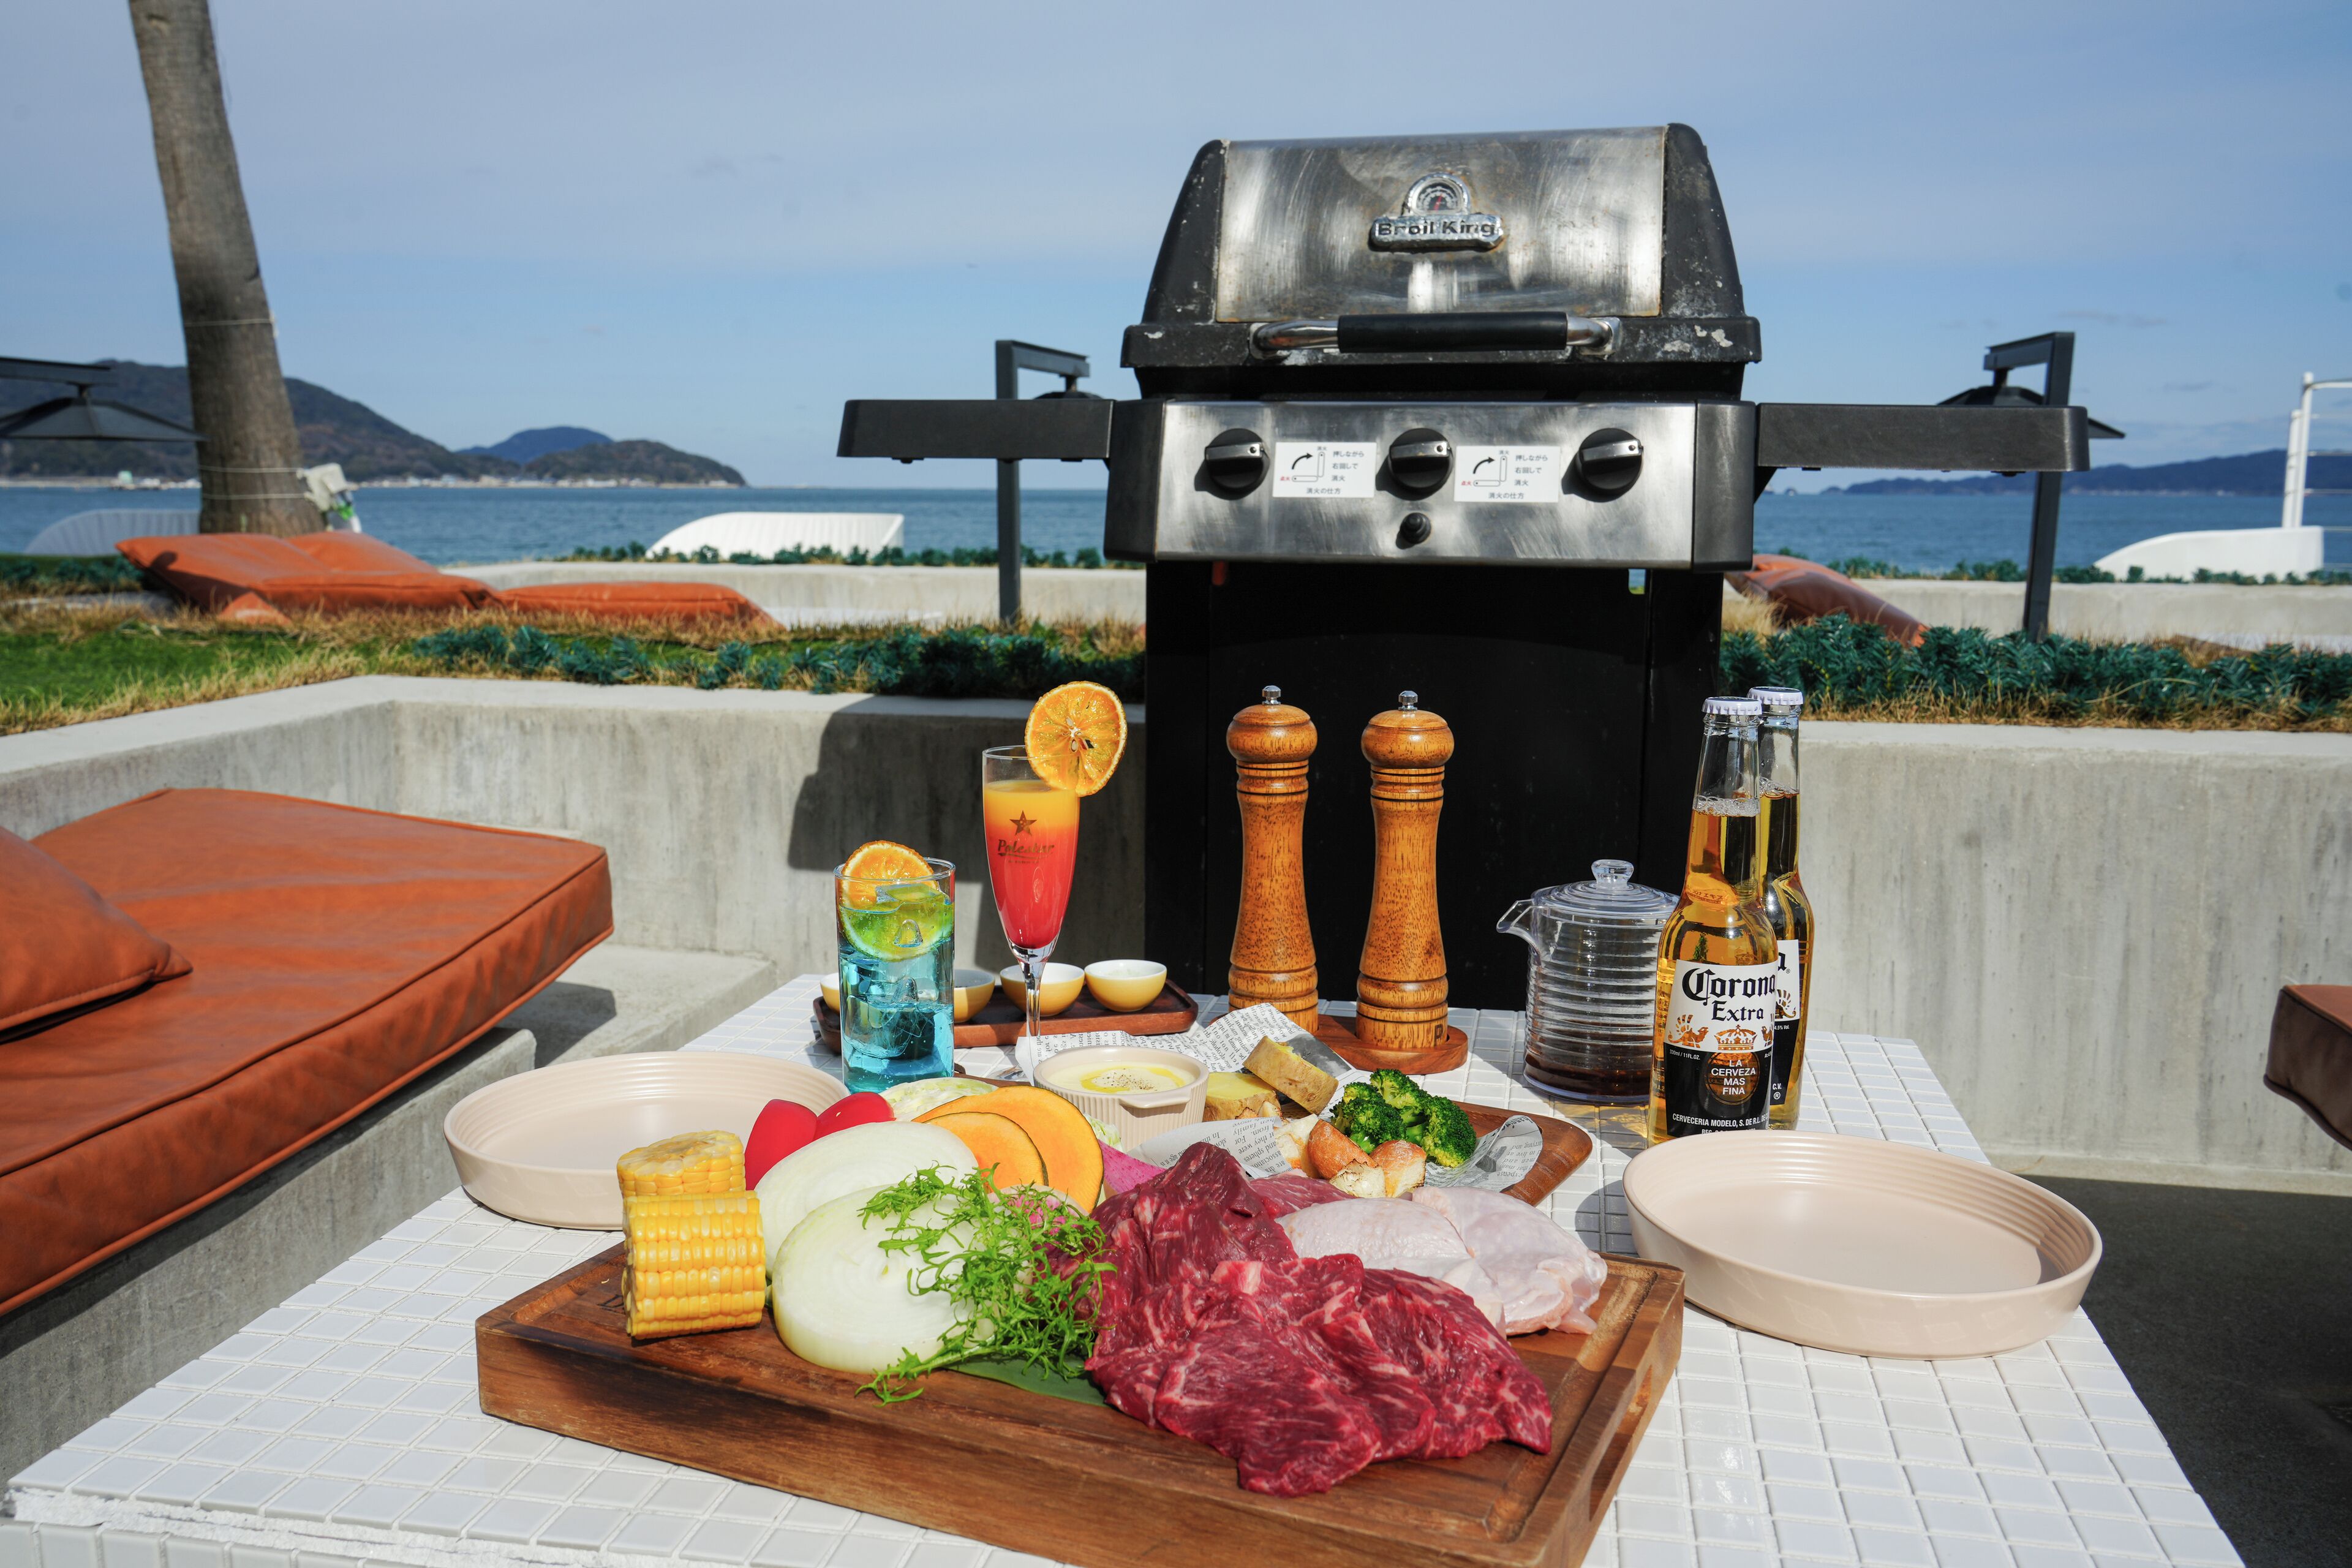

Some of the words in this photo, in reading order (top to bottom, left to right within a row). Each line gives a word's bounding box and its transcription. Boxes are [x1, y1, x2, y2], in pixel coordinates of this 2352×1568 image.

[1378, 220, 1434, 235] Broil
[1442, 221, 1495, 237] King
[1682, 968, 1776, 1006] Corona
[1711, 1000, 1763, 1022] Extra
[1711, 1067, 1756, 1076] CERVEZA
[1724, 1077, 1746, 1086] MAS
[1672, 1113, 1709, 1126] CERVECERIA
[1711, 1119, 1738, 1128] MODELO,
[1251, 1125, 1269, 1136] from.
[1235, 1135, 1246, 1145] For
[1254, 1135, 1267, 1145] they
[1238, 1144, 1253, 1154] were
[1265, 1141, 1276, 1153] and
[1242, 1147, 1264, 1162] spheres
